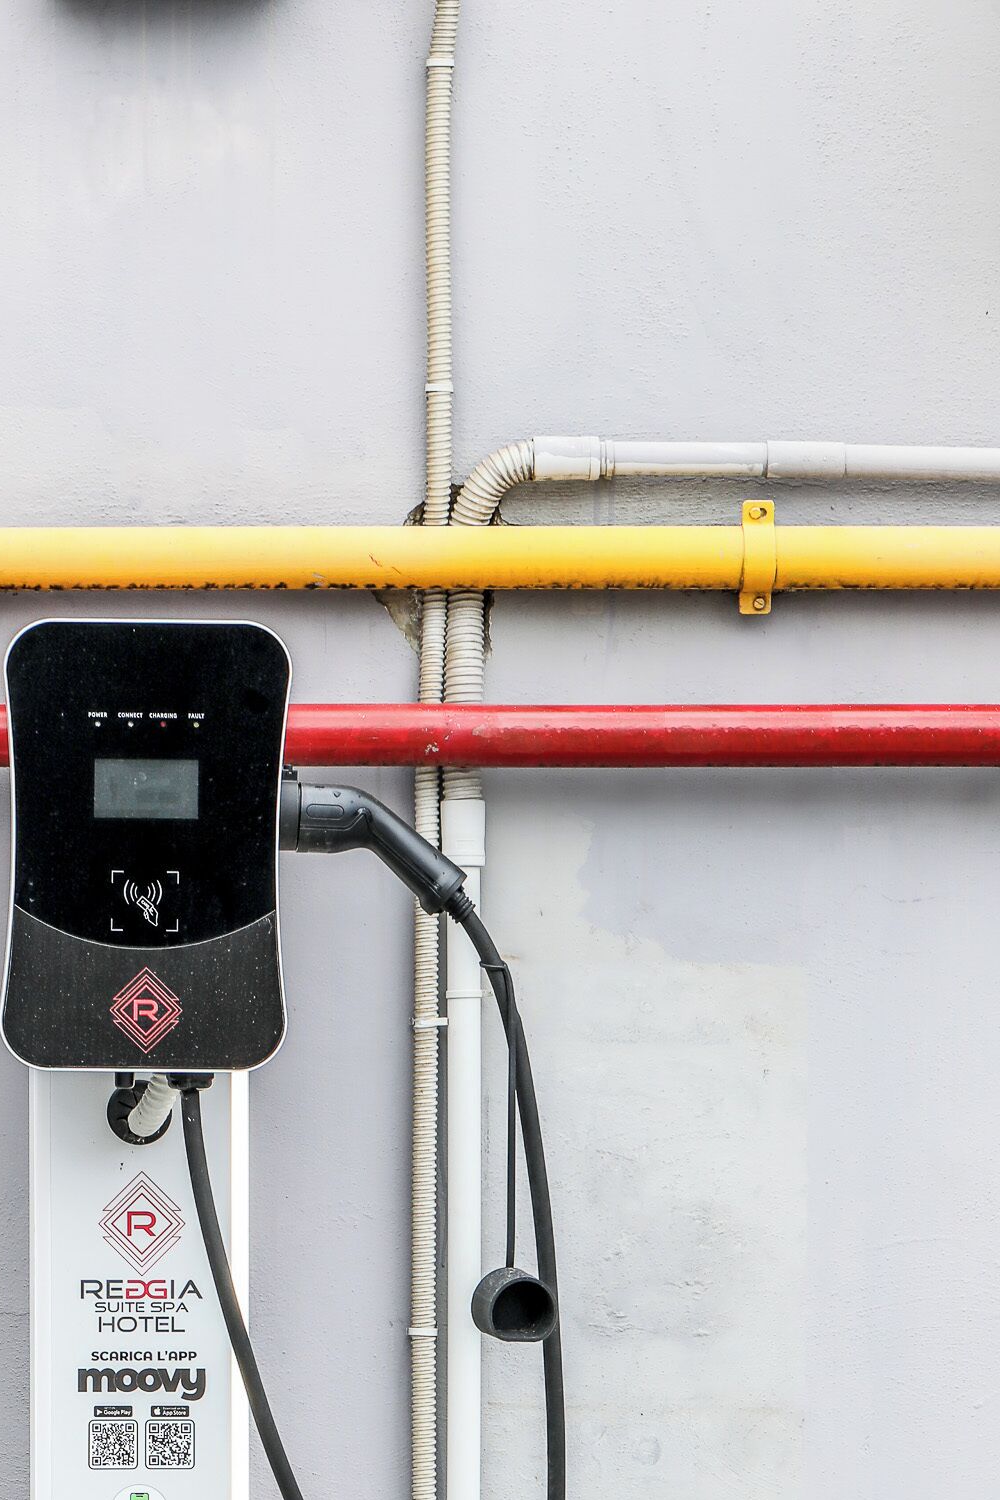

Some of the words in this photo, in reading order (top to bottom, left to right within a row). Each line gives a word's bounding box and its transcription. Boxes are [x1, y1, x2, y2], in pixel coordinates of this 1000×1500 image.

[117, 711, 143, 719] CONNECT
[133, 999, 158, 1021] R
[126, 1211, 157, 1237] R
[95, 1301, 145, 1313] SUITE
[150, 1301, 189, 1313] SPA
[98, 1316, 186, 1333] HOTEL
[91, 1351, 153, 1361] SCARICA
[157, 1351, 197, 1361] L'APP
[77, 1368, 206, 1401] moovy
[103, 1409, 120, 1417] Google
[120, 1409, 131, 1417] Play
[162, 1409, 173, 1417] App
